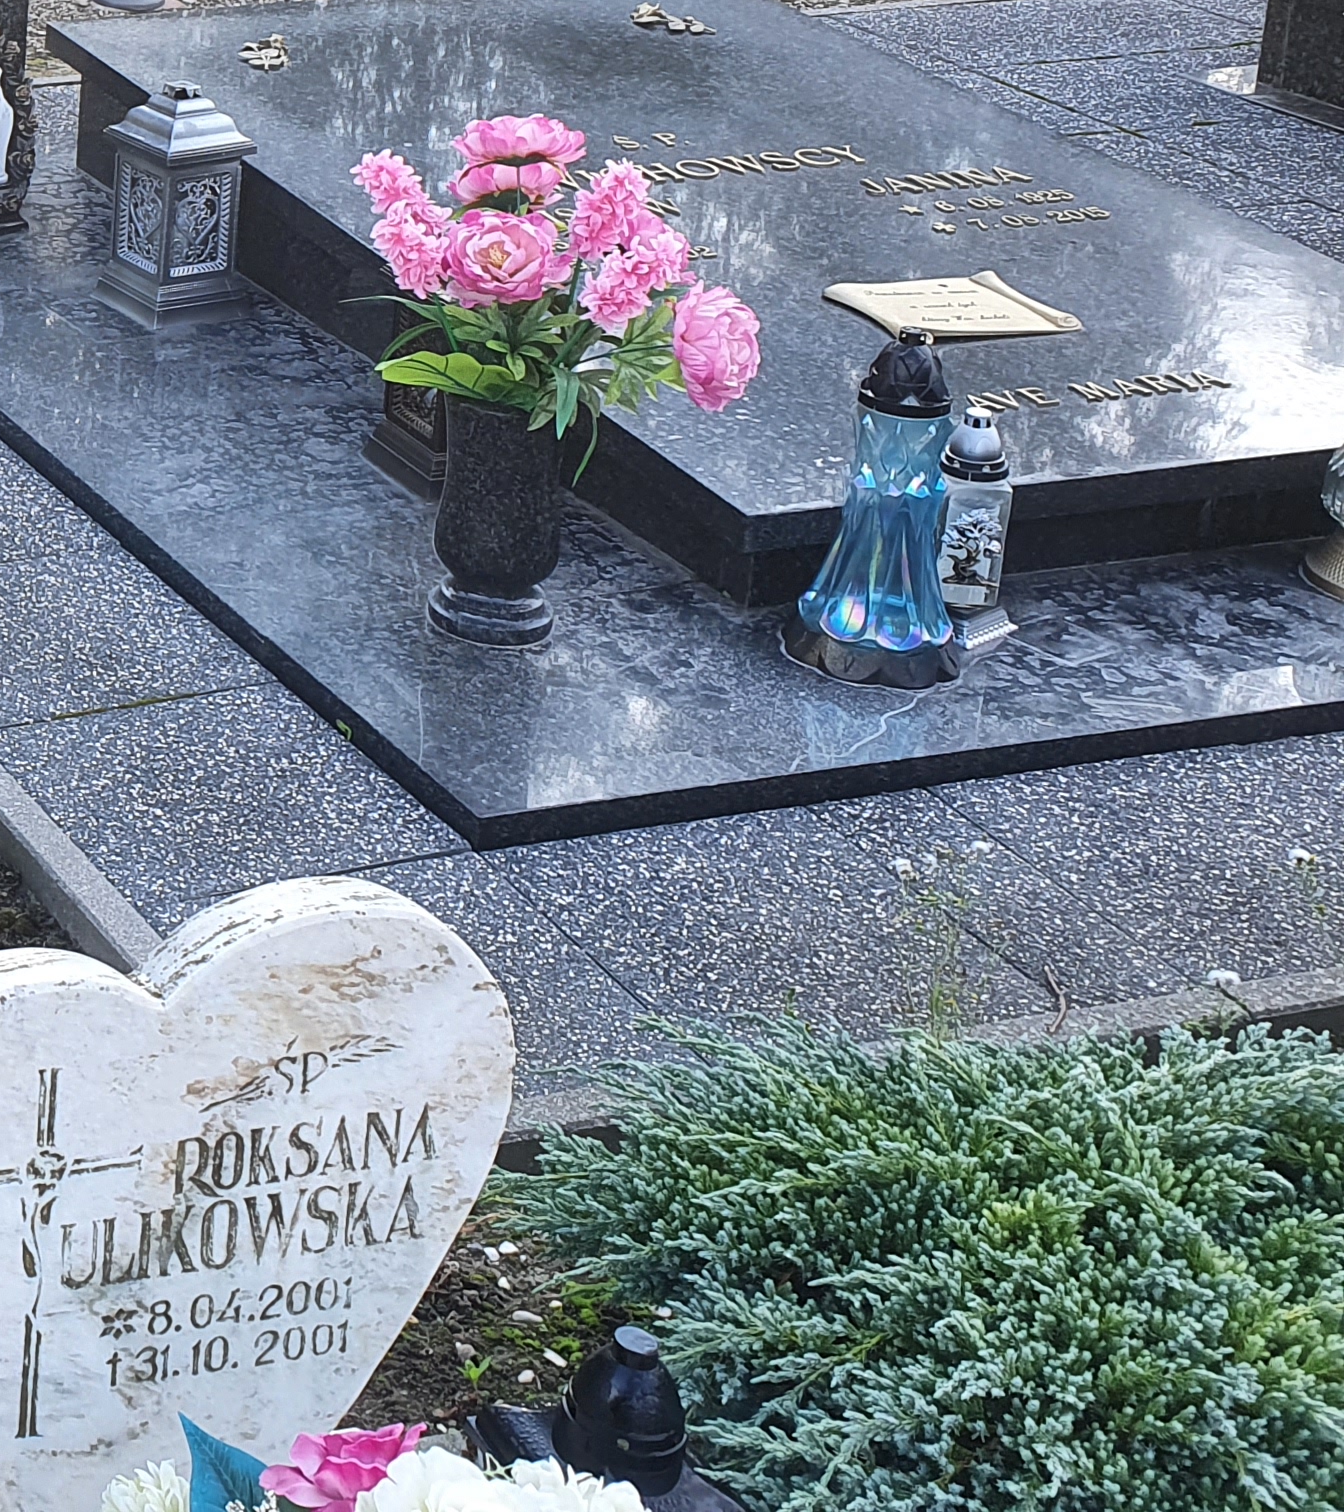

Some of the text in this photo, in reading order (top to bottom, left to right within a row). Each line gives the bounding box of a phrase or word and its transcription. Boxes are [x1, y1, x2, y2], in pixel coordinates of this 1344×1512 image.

[860, 165, 1034, 197] JANINA
[966, 368, 1233, 414] AVE MARIA
[174, 1102, 441, 1198] ROKSANA
